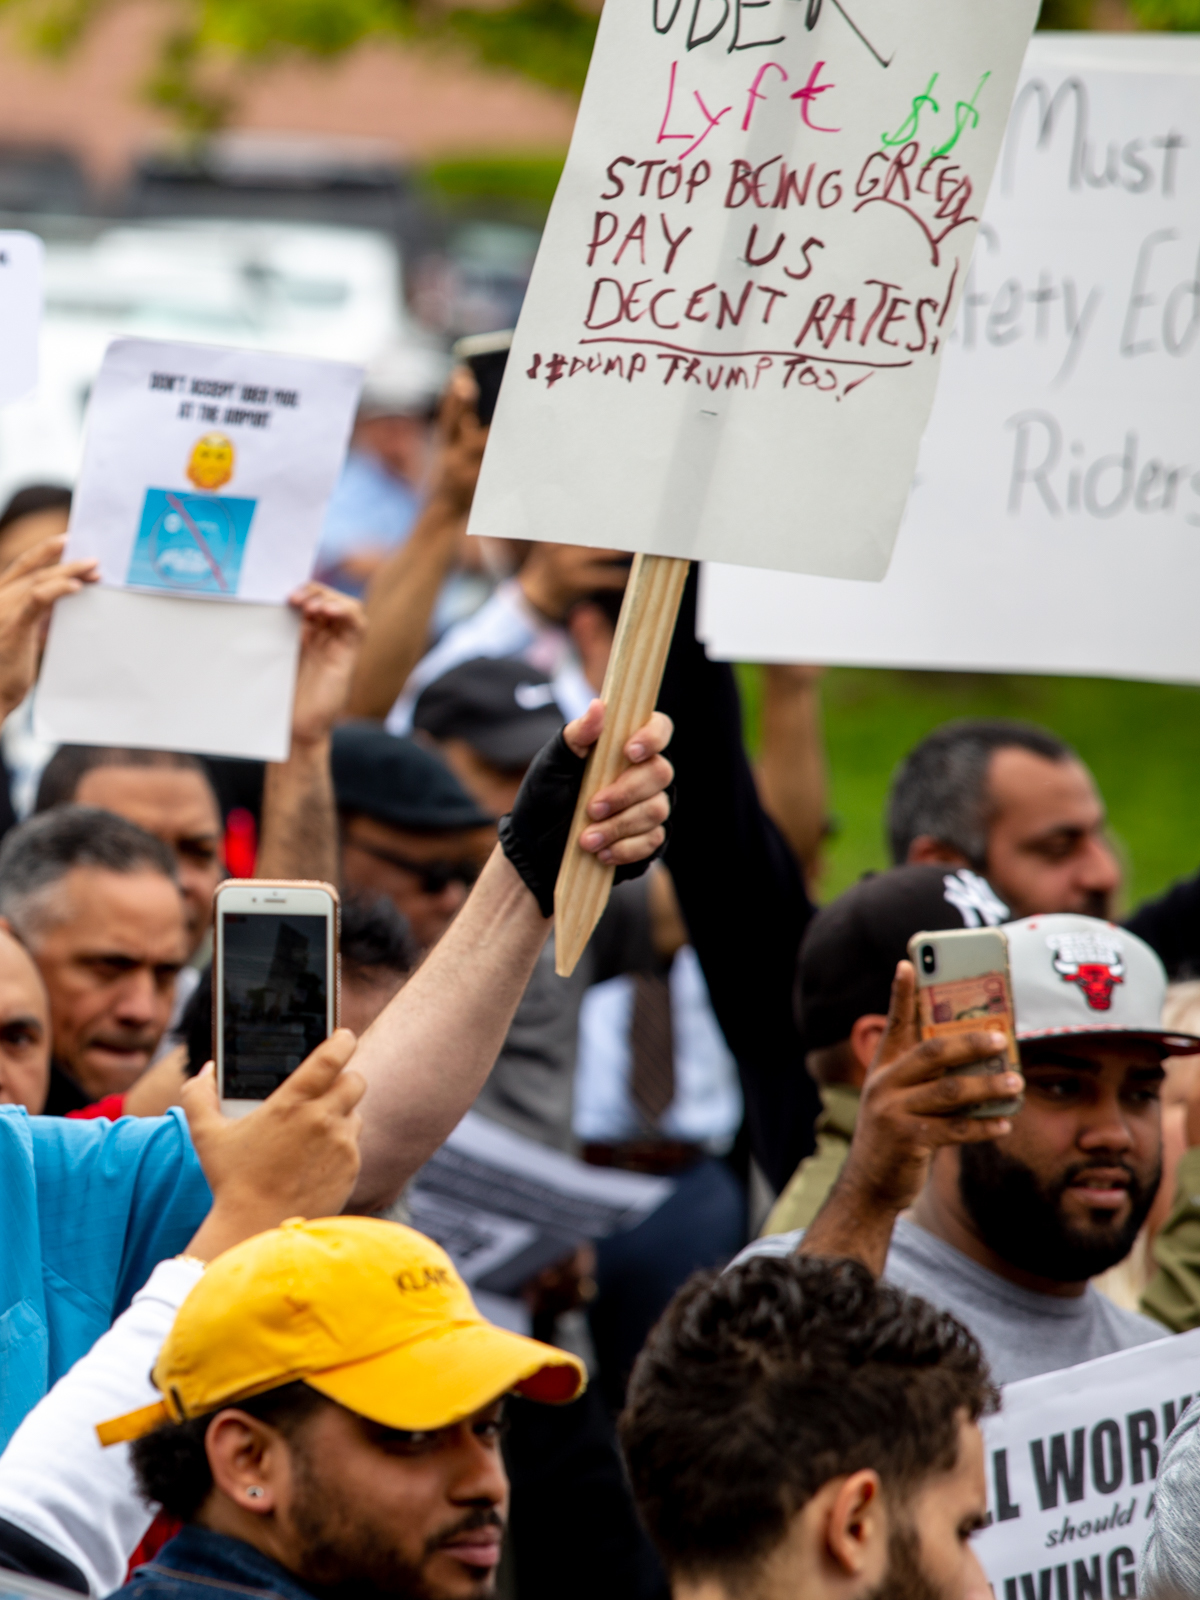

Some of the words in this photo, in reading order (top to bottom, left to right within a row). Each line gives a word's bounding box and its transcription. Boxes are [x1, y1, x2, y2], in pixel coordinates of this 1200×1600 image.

[657, 60, 842, 160] Lyft
[600, 155, 711, 203] STOP
[724, 155, 843, 209] BEING
[587, 211, 693, 274] PAY
[744, 224, 826, 279] US
[584, 278, 788, 330] DECENT
[657, 353, 773, 390] TRUMP
[1044, 1498, 1137, 1549] should
